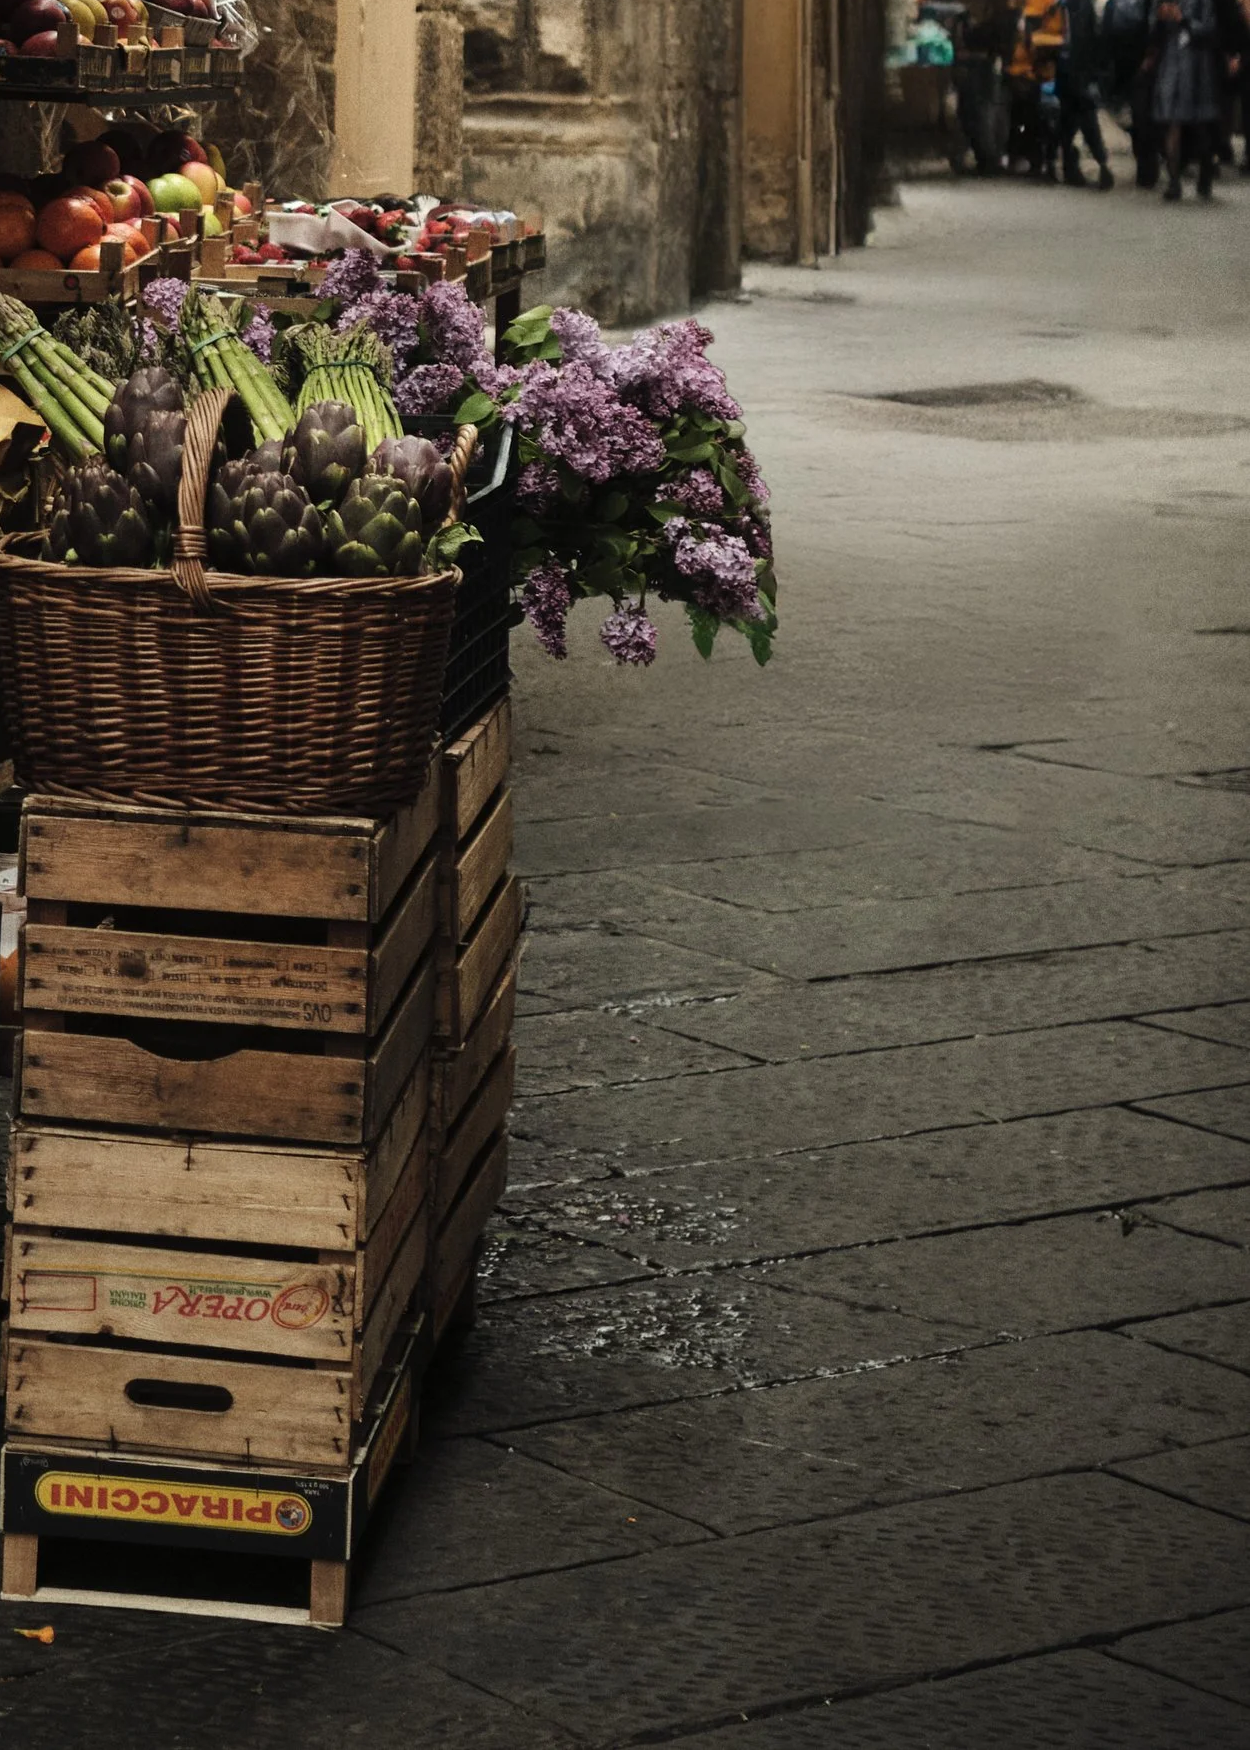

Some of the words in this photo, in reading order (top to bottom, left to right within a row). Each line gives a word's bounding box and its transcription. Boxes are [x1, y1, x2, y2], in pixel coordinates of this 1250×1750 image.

[301, 1001, 332, 1023] OVS
[151, 1285, 271, 1322] OPERA
[50, 1482, 273, 1525] PIRACCINI
